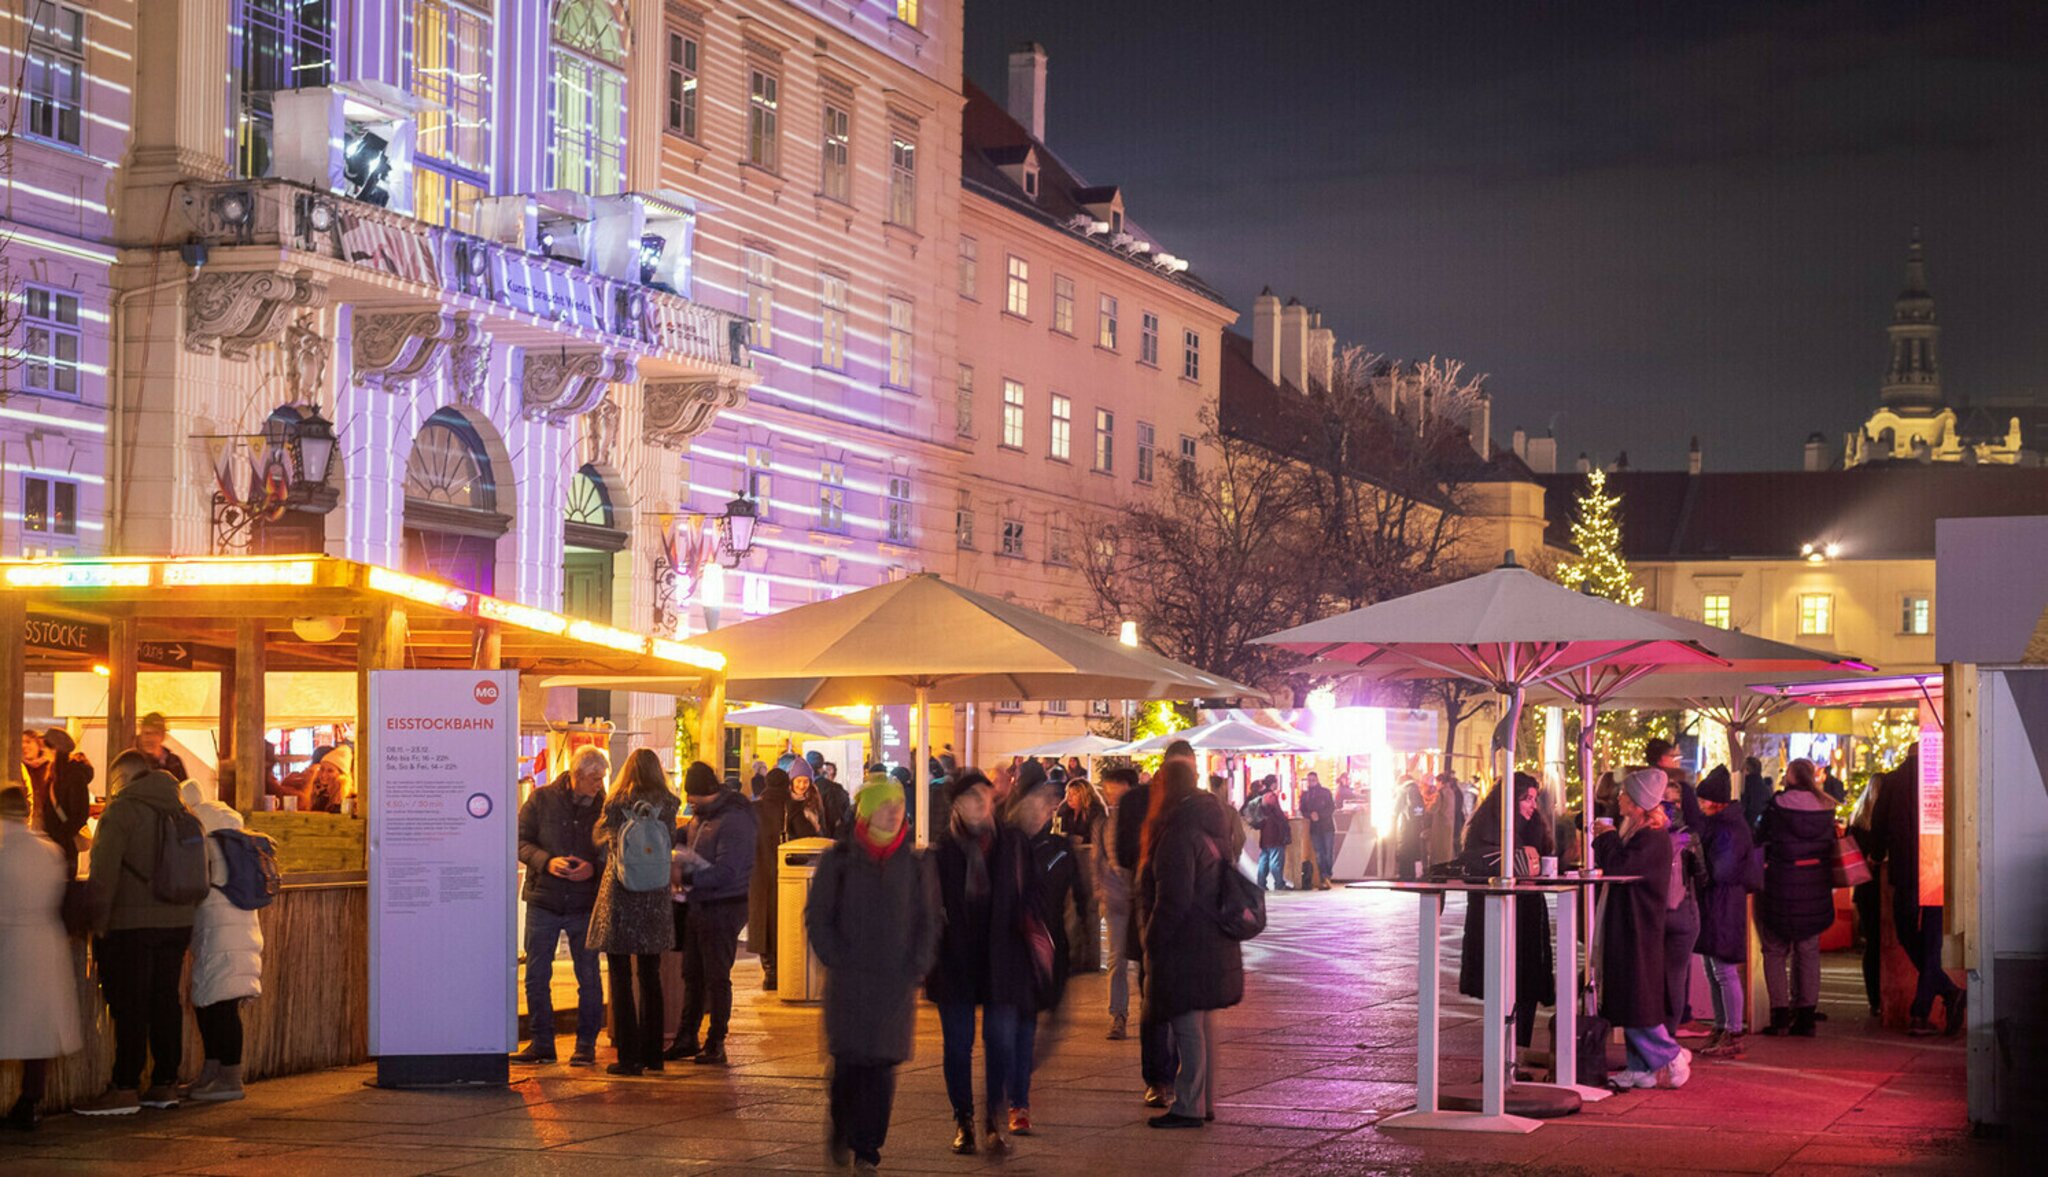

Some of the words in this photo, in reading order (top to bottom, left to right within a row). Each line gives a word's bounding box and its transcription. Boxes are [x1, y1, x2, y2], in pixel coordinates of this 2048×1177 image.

[475, 687, 498, 698] MQ
[386, 717, 494, 730] EISSTOCKBAHN
[386, 754, 398, 762] Mo
[400, 754, 410, 762] bis
